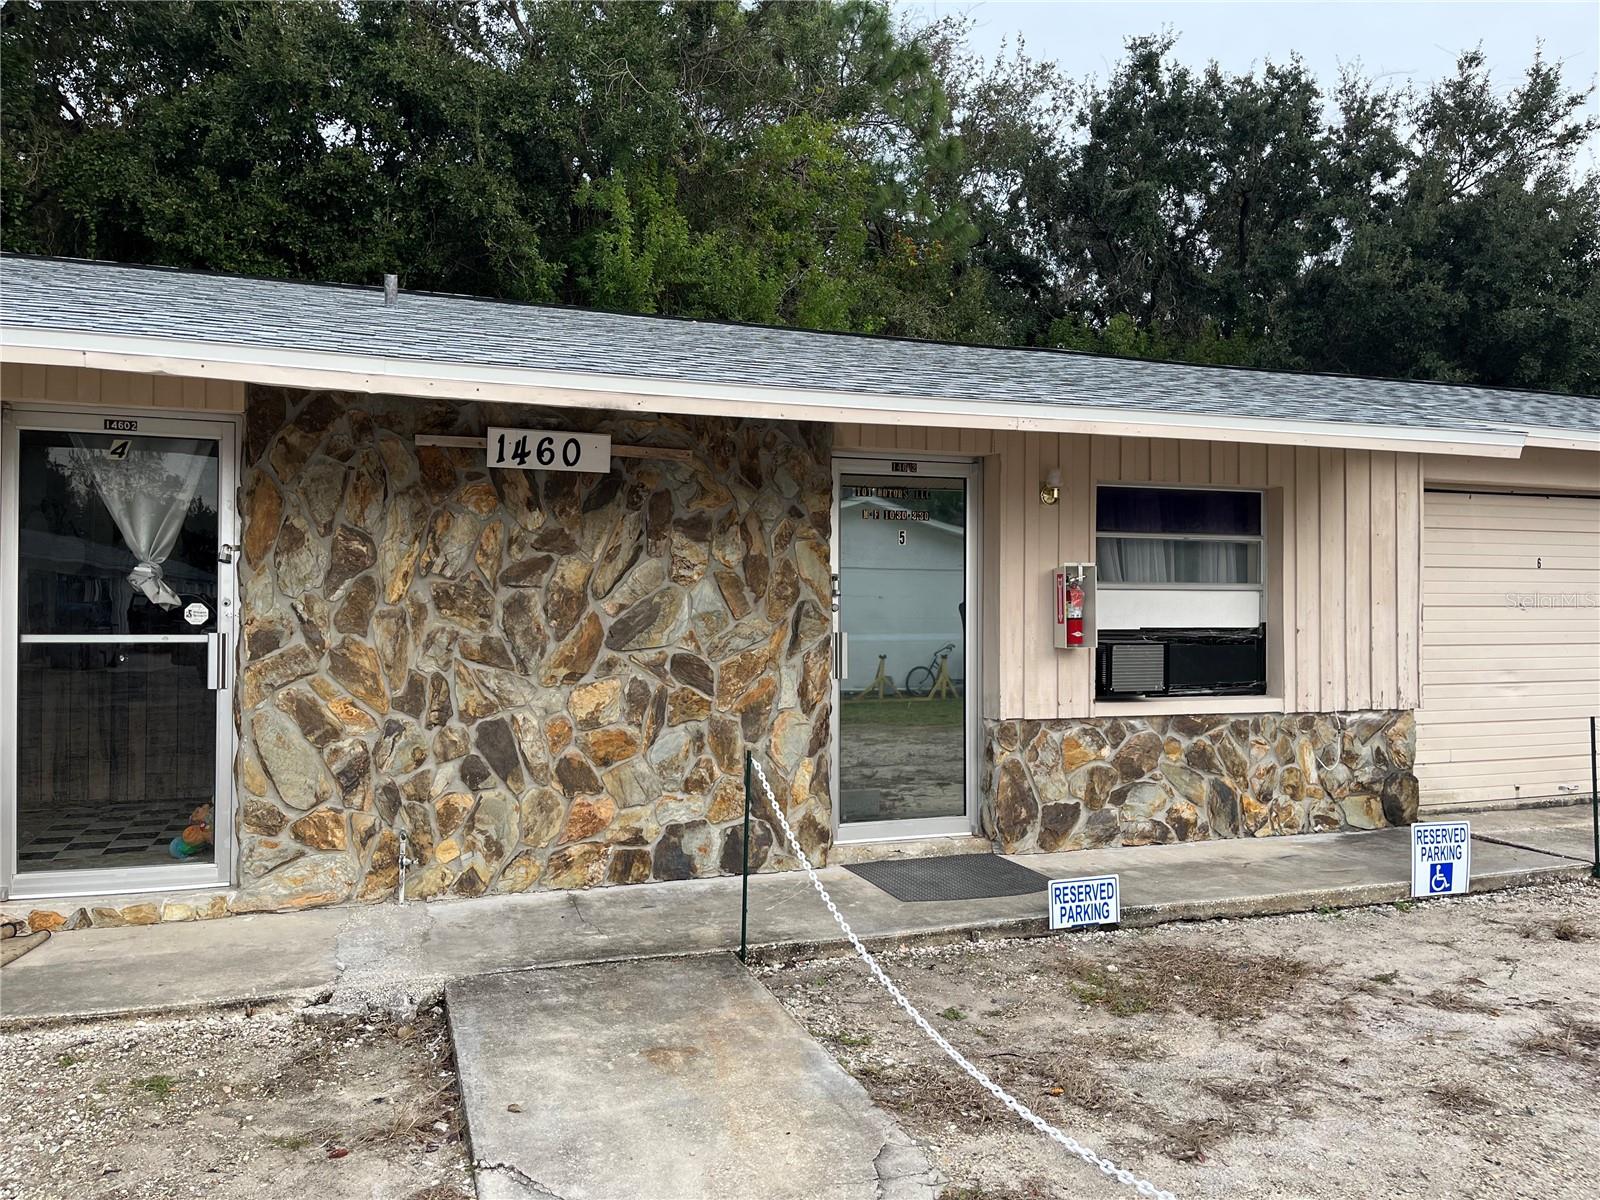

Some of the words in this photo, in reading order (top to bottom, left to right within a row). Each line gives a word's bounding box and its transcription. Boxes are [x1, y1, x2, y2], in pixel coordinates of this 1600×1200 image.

[105, 420, 137, 431] 14602
[110, 440, 129, 459] 4
[496, 433, 581, 467] 1460
[899, 531, 906, 545] 5
[1536, 557, 1543, 569] 6
[1416, 827, 1467, 845] RESERVED
[1421, 845, 1462, 862] PARKING
[1054, 882, 1114, 904] RESERVED
[1060, 902, 1110, 924] PARKING
